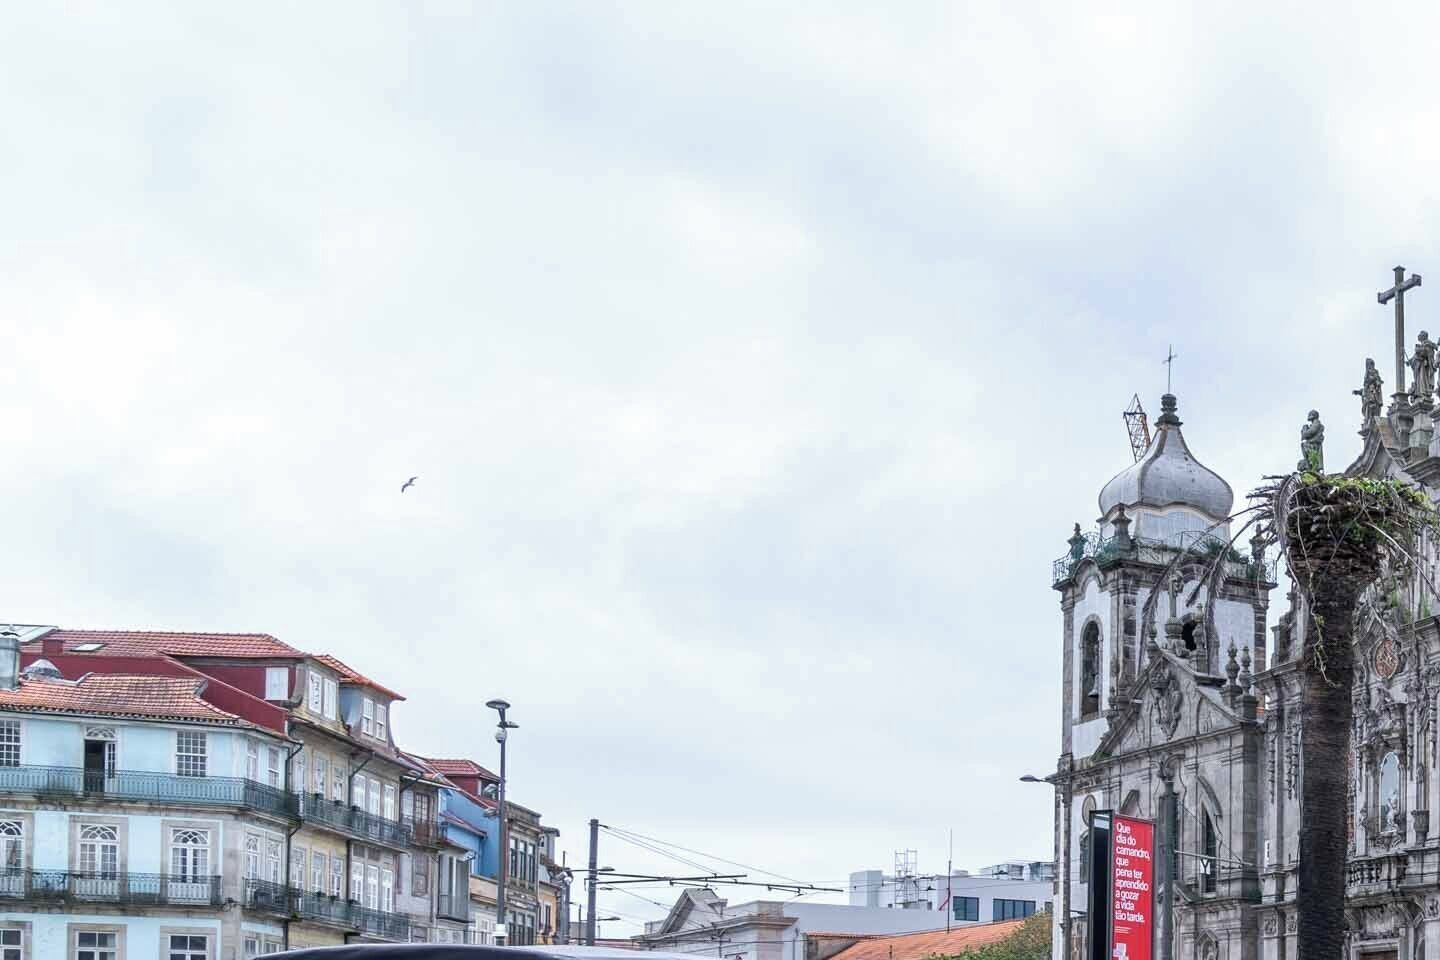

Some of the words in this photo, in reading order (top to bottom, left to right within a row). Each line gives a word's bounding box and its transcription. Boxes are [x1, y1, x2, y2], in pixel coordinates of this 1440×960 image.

[1116, 822, 1131, 834] Que
[1116, 834, 1127, 845] dia
[1127, 835, 1137, 847] do
[1116, 847, 1150, 860] camandro,
[1116, 857, 1129, 868] que
[1115, 868, 1133, 879] pena
[1133, 869, 1143, 880] ter
[1115, 879, 1149, 891] aprendido
[1121, 891, 1139, 901] gozar
[1121, 900, 1135, 911] vida
[1115, 910, 1127, 920] tão
[1127, 911, 1145, 923] tarde.
